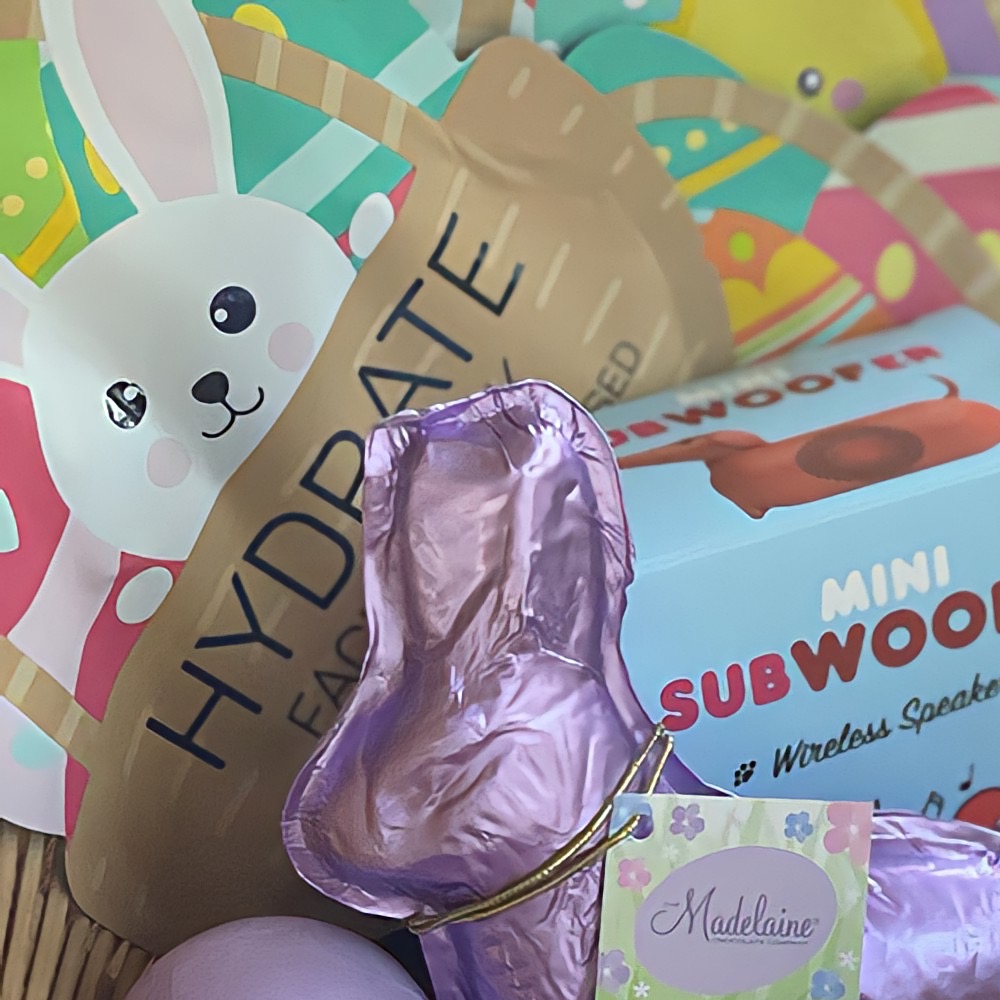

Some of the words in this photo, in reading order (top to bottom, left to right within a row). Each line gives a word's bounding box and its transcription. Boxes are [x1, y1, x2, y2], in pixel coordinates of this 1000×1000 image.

[820, 545, 951, 622] MINI
[772, 717, 892, 778] Wireless
[650, 886, 815, 942] Madelaine
